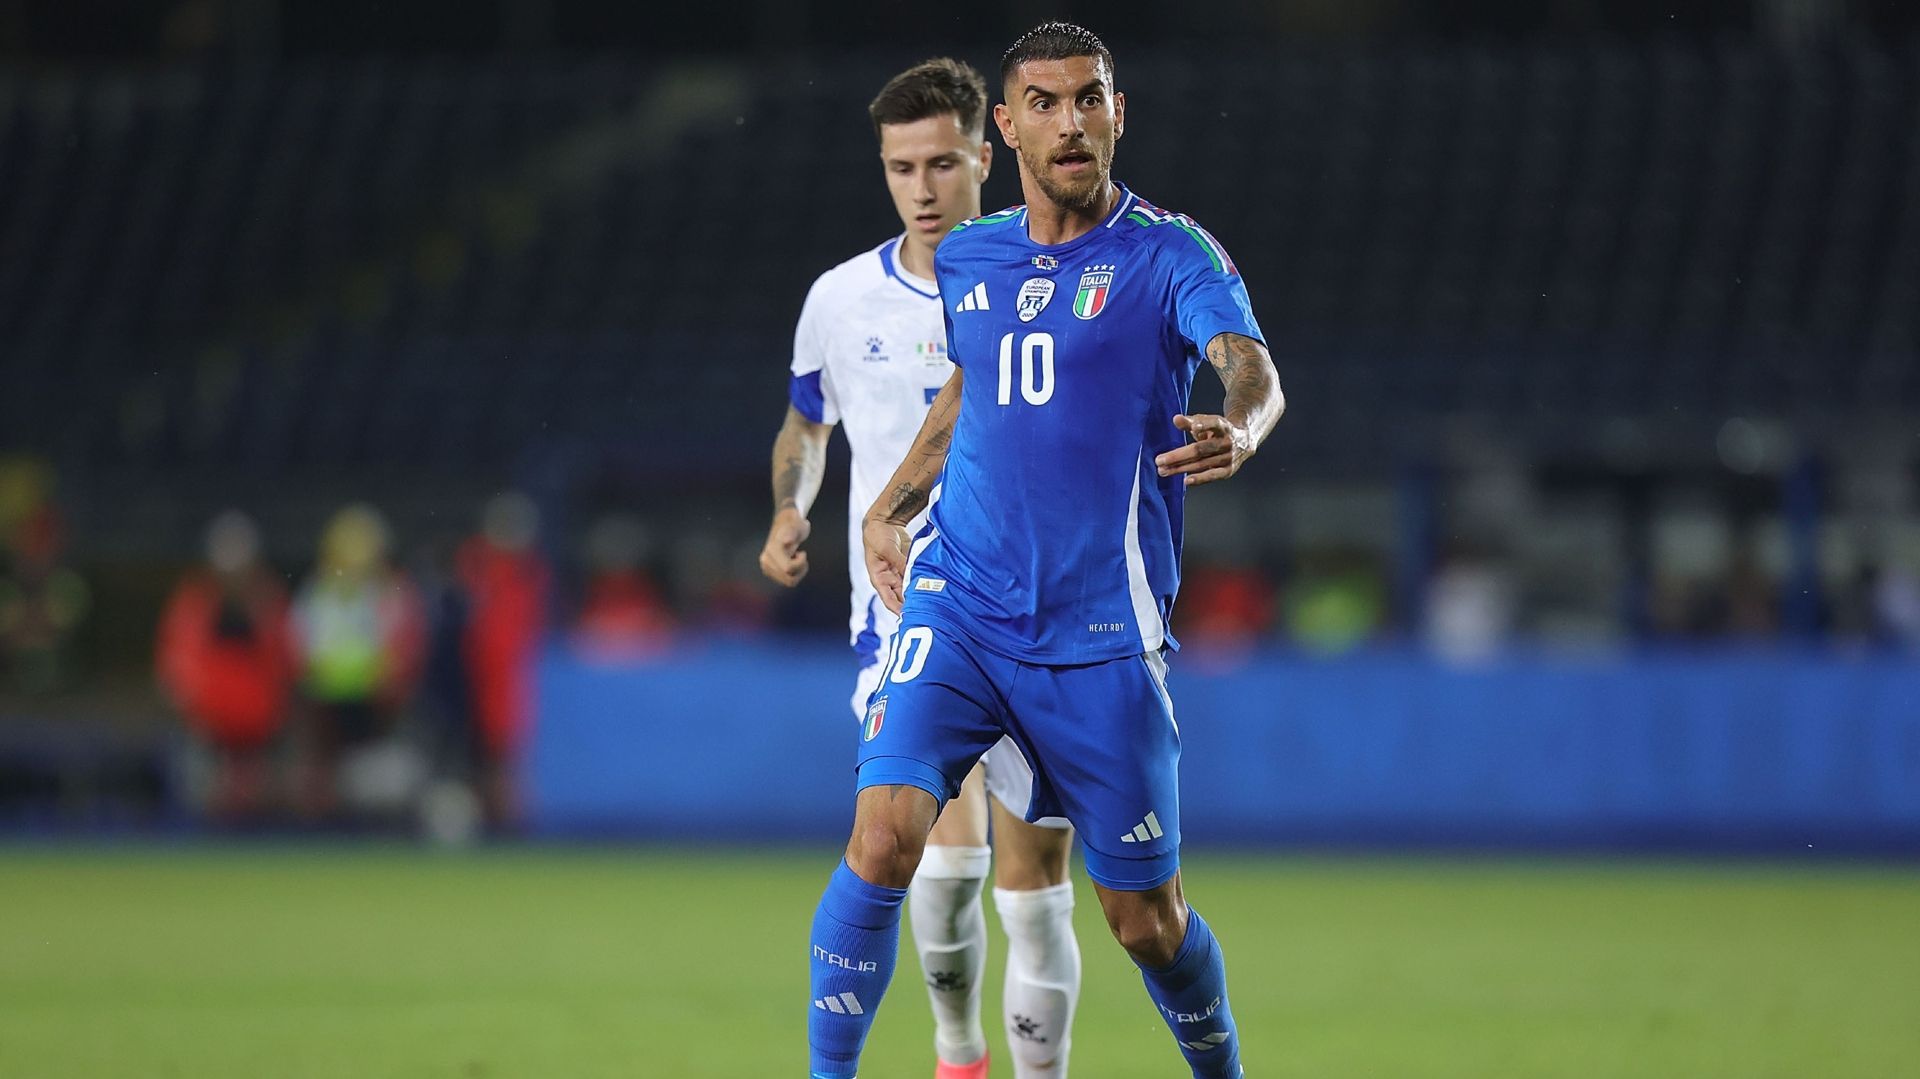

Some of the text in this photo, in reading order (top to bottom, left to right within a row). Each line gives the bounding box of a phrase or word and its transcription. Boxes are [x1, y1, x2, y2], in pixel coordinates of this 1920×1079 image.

[1082, 275, 1109, 287] ITALIA
[997, 332, 1056, 406] 10
[1089, 623, 1125, 632] HEAT.RDY
[814, 944, 878, 973] ITALIA
[1159, 996, 1221, 1023] ITALIA
